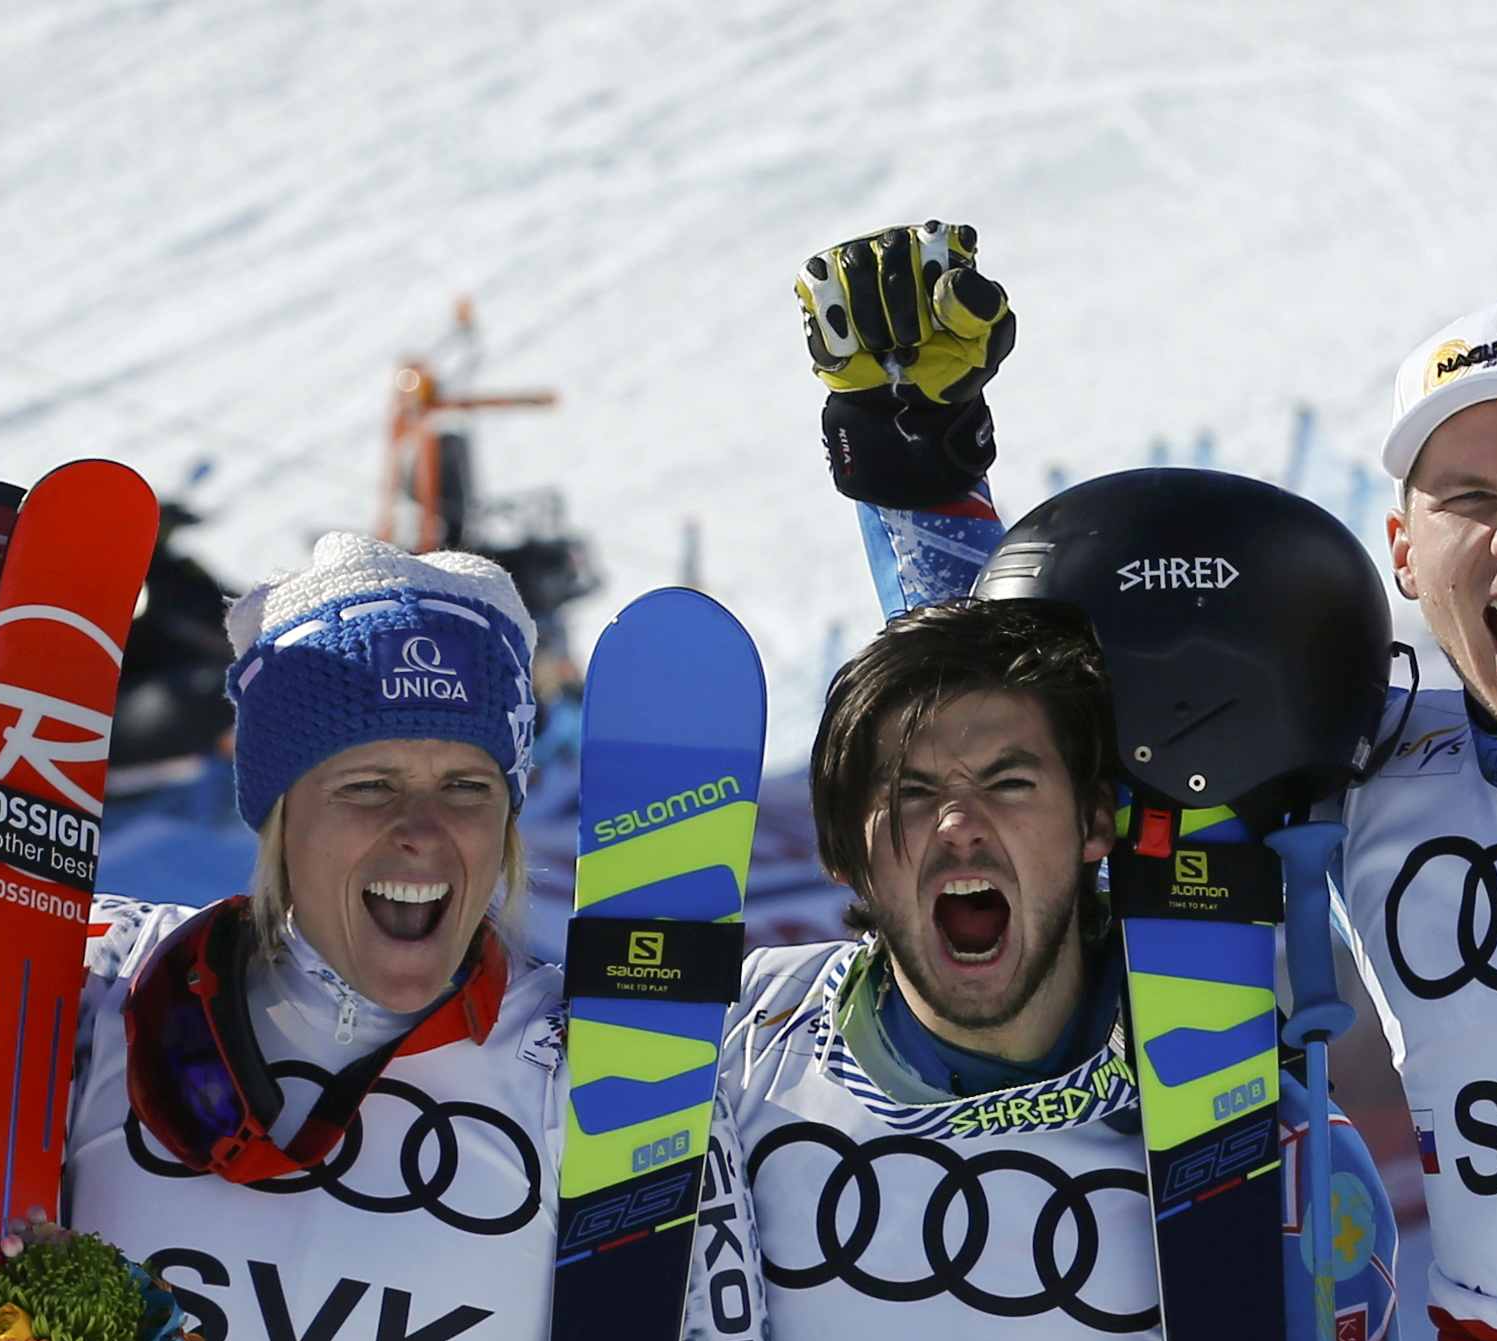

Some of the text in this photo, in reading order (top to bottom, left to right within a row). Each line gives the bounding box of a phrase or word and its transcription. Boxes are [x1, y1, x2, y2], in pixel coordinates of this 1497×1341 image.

[1116, 557, 1240, 593] SHRED
[381, 675, 469, 704] UNIQA
[50, 846, 96, 881] best
[1188, 902, 1199, 910] TO
[616, 982, 669, 993] TIME TO PLAY
[946, 1086, 1092, 1135] SHRED
[1215, 1078, 1265, 1120] LAB
